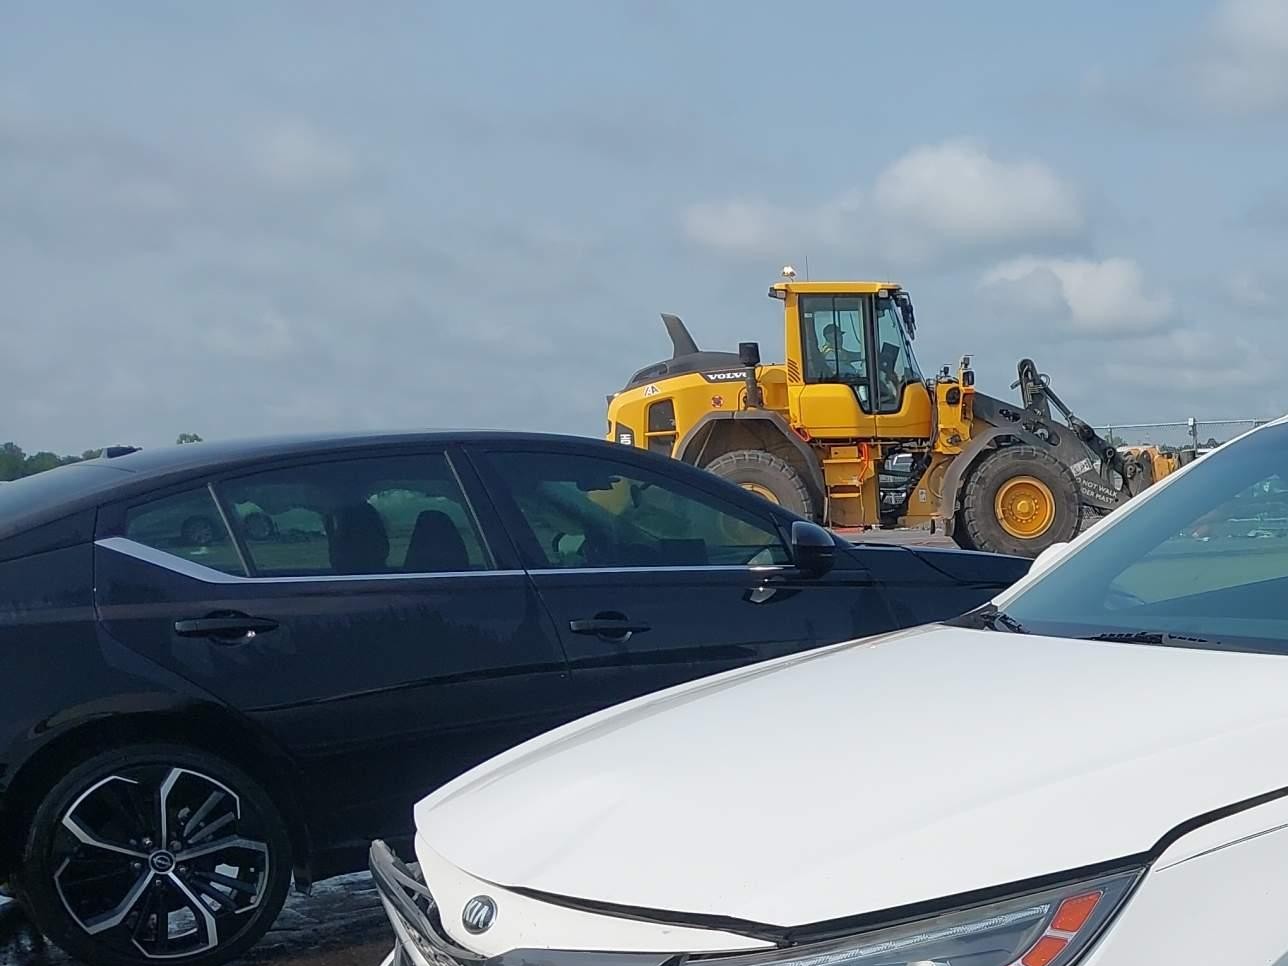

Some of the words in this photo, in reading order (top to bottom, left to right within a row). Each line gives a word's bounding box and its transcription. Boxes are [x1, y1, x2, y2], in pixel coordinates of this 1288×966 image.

[1081, 487, 1095, 496] DER
[1095, 493, 1114, 504] MAST
[1082, 479, 1098, 489] NOT
[1098, 485, 1118, 498] WALK
[463, 899, 489, 929] KIA
